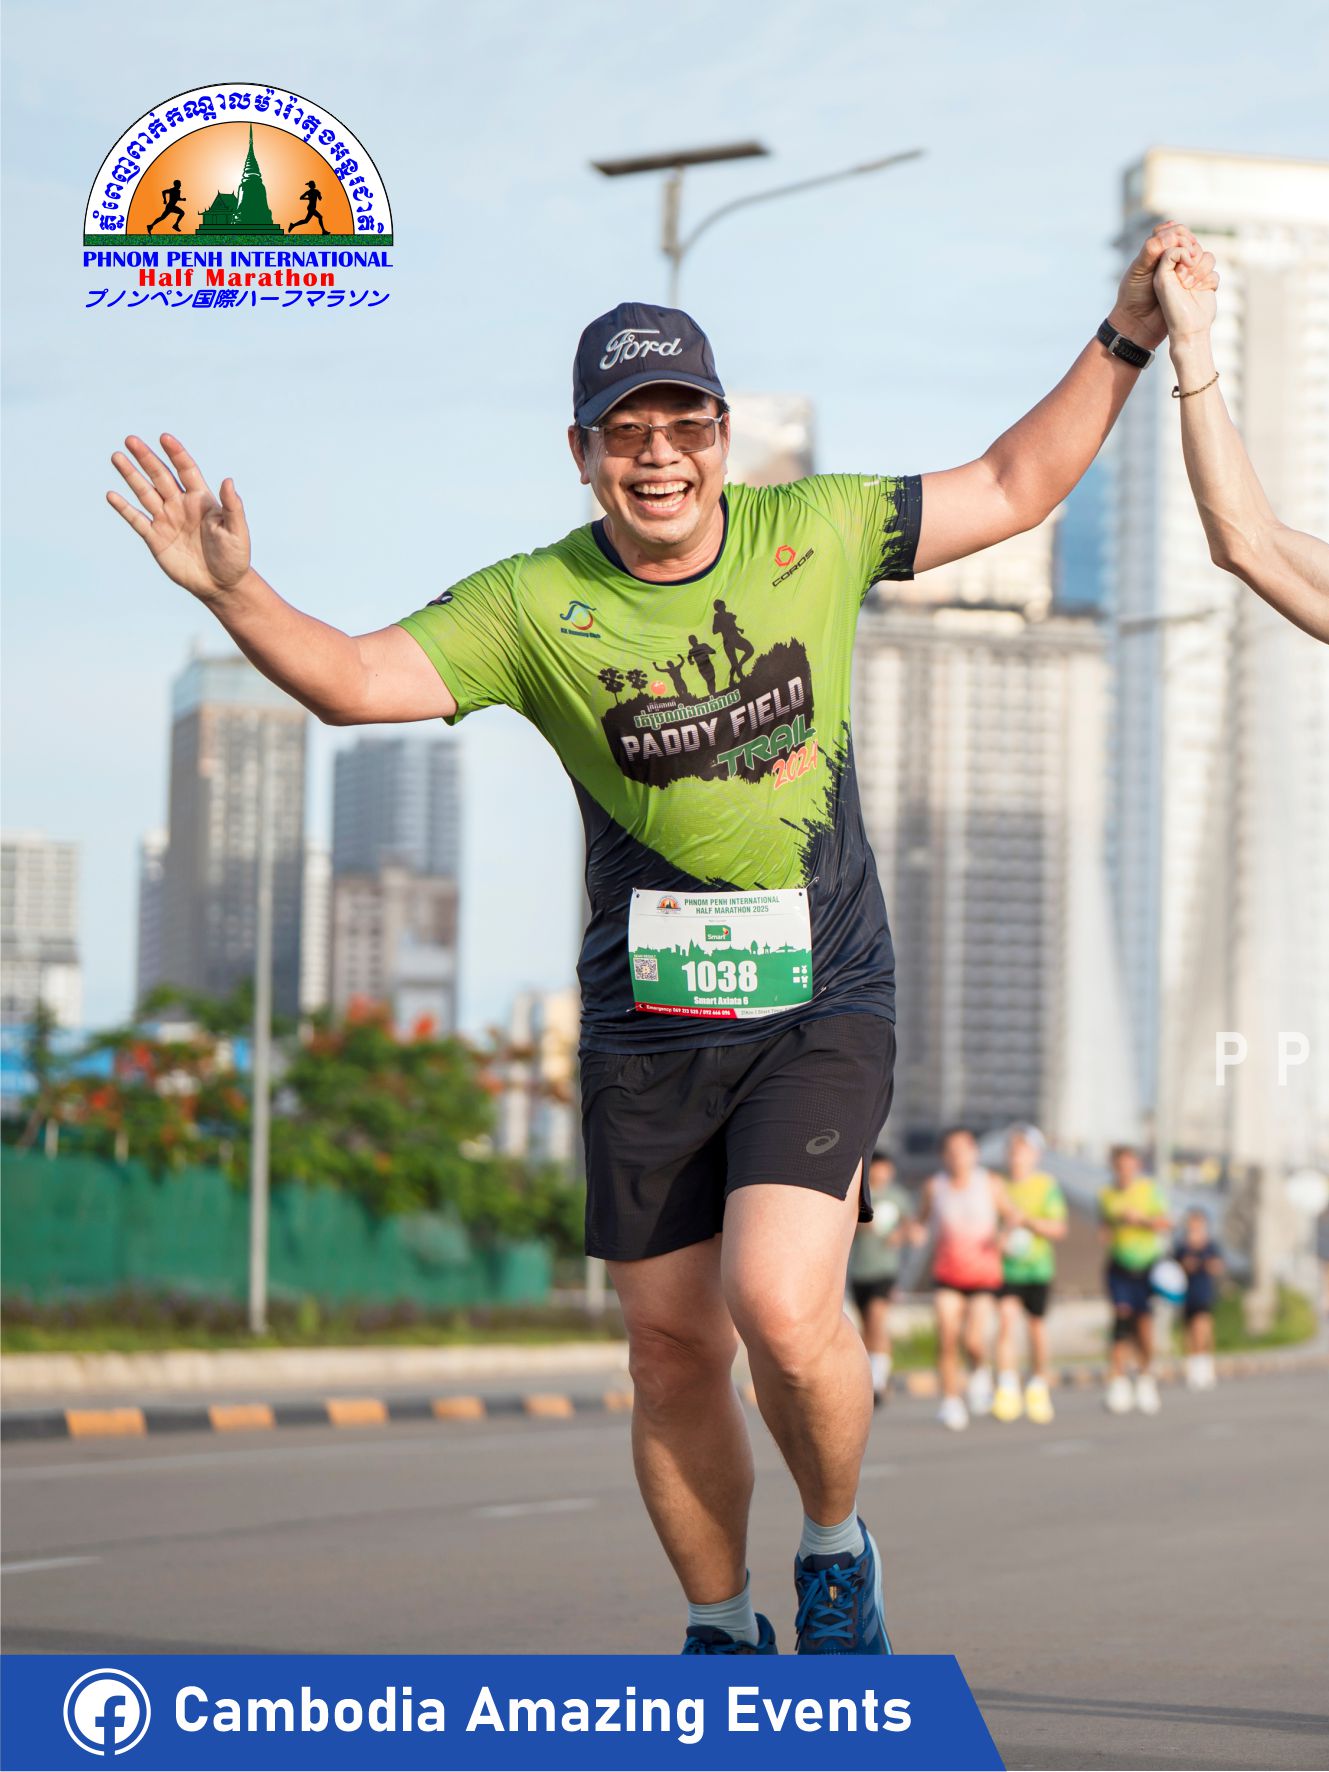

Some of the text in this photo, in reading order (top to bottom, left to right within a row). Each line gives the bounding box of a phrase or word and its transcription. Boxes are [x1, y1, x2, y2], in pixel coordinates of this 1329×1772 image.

[600, 328, 682, 370] Ford
[772, 547, 815, 587] COROS
[620, 676, 806, 762] PADDY FIELD
[717, 713, 817, 779] TRAIL
[684, 896, 780, 906] PHNOM PENH INTERNATIONAL
[695, 904, 769, 914] HALF MARATHON 2025
[681, 960, 758, 993] 1038
[694, 996, 717, 1005] Smart
